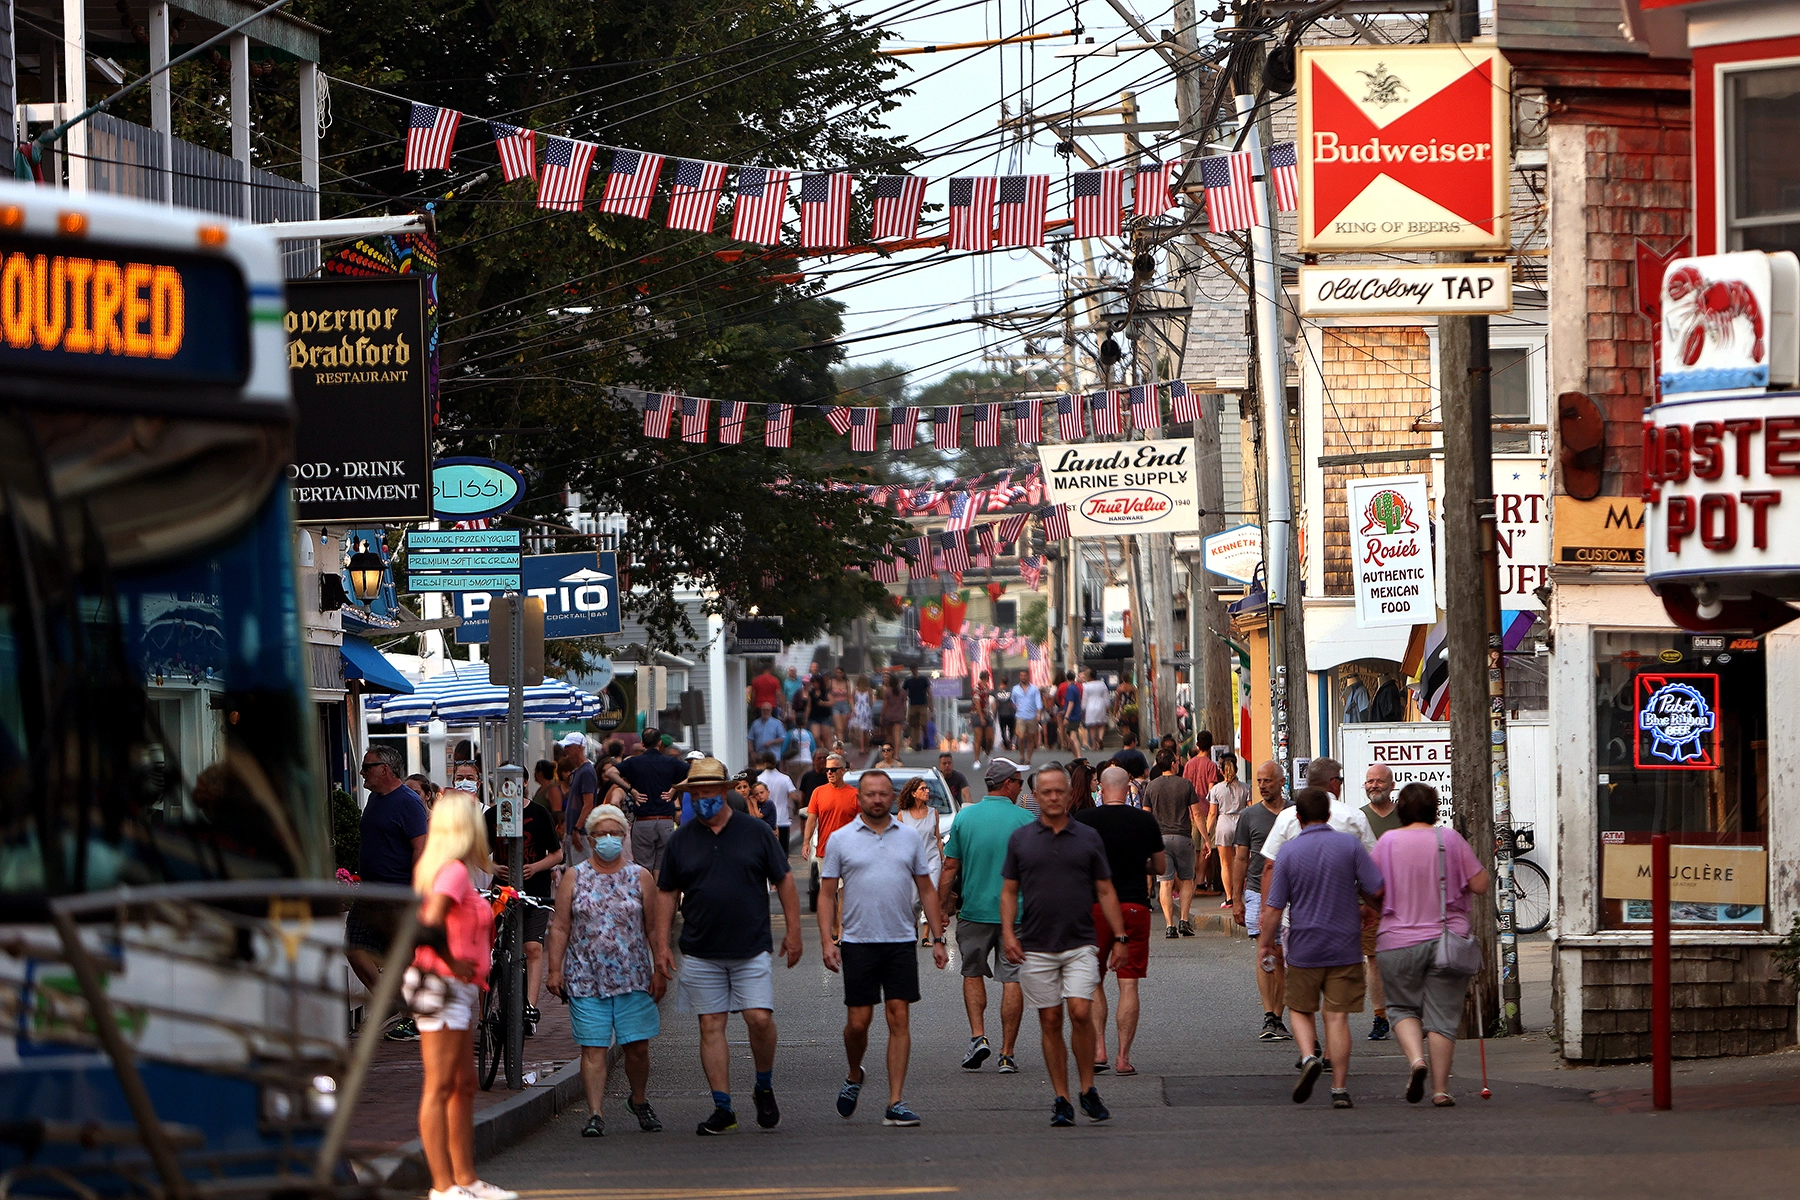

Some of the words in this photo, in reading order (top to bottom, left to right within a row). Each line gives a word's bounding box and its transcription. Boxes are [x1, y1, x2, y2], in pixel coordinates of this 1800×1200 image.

[1313, 132, 1491, 164] Budweiser
[1335, 222, 1377, 234] KING
[1381, 222, 1404, 234] OF
[1318, 277, 1361, 301] Old
[1359, 277, 1434, 304] Colony
[1442, 276, 1495, 299] TAP
[283, 308, 399, 334] overnor
[287, 333, 410, 368] Bradford
[315, 370, 409, 385] RESTAURANT
[1051, 449, 1130, 473] Lands
[1133, 445, 1188, 468] End
[343, 460, 406, 477] DRINK
[1054, 474, 1118, 489] MARINE
[1124, 470, 1188, 486] SUPPLY
[1108, 514, 1144, 522] HARDWARE
[1667, 489, 1783, 556] POT
[455, 534, 486, 545] FROZEN
[487, 534, 517, 544] YOGURT
[1211, 539, 1256, 556] KENNETH
[1363, 538, 1421, 567] Rosie's
[1576, 549, 1631, 561] CUSTOM
[409, 557, 450, 567] PREMIUM
[450, 557, 472, 566] SOFT
[473, 557, 485, 565] ICE
[487, 556, 519, 566] CREAM
[411, 579, 441, 587] FRESH
[442, 579, 467, 587] FRUIT
[468, 578, 517, 587] SMOOTHIES
[1362, 568, 1425, 584] AUTHENTIC
[1370, 584, 1419, 599] MEXICAN
[462, 585, 609, 619] PTIO
[1381, 600, 1411, 614] FOOD
[546, 613, 587, 621] COCKTAIL
[1659, 694, 1697, 713] Pabst
[1645, 712, 1670, 727] Blue
[1670, 712, 1709, 727] Ribbon
[1373, 745, 1424, 761] RENT
[1427, 748, 1437, 760] a
[1604, 832, 1625, 840] ATM
[1637, 863, 1734, 882] MUCLÈRE
